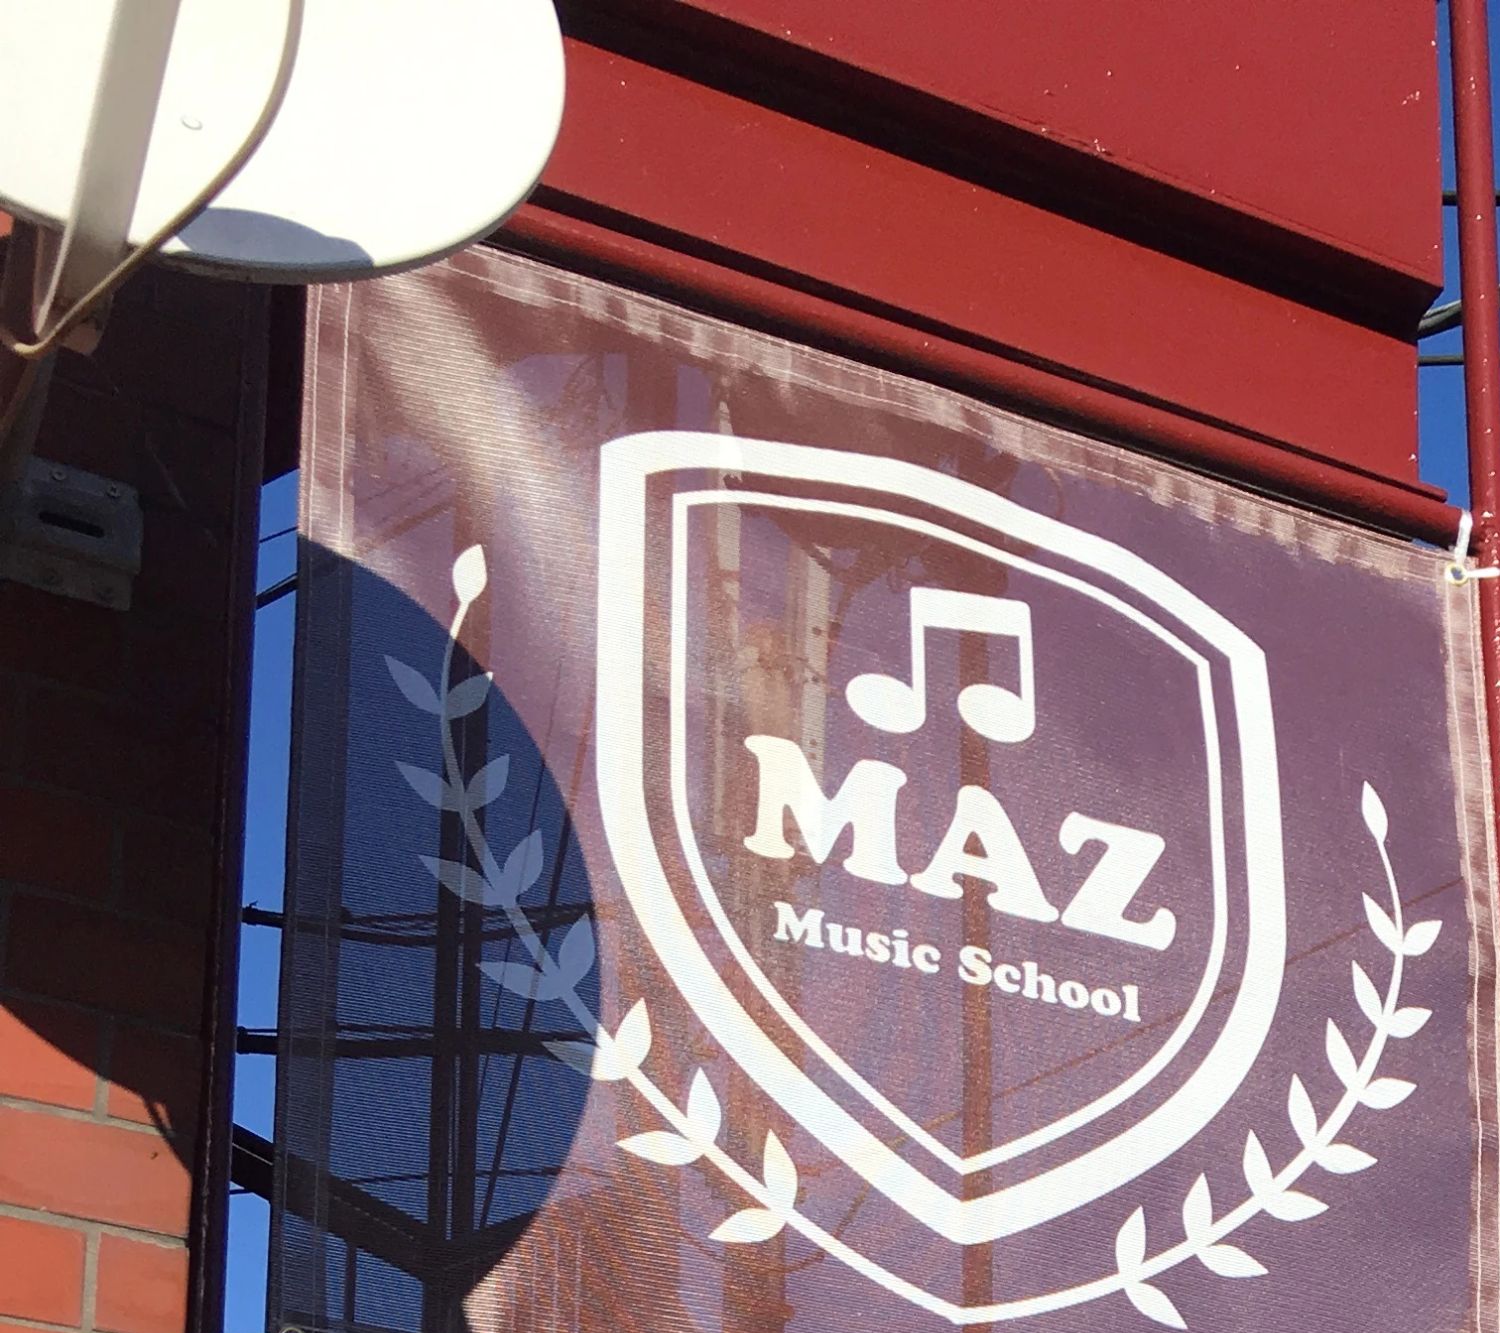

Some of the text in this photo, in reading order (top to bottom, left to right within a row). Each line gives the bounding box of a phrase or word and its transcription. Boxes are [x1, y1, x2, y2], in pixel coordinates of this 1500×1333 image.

[743, 734, 1177, 951] MAZ
[773, 901, 1142, 1022] Music School
